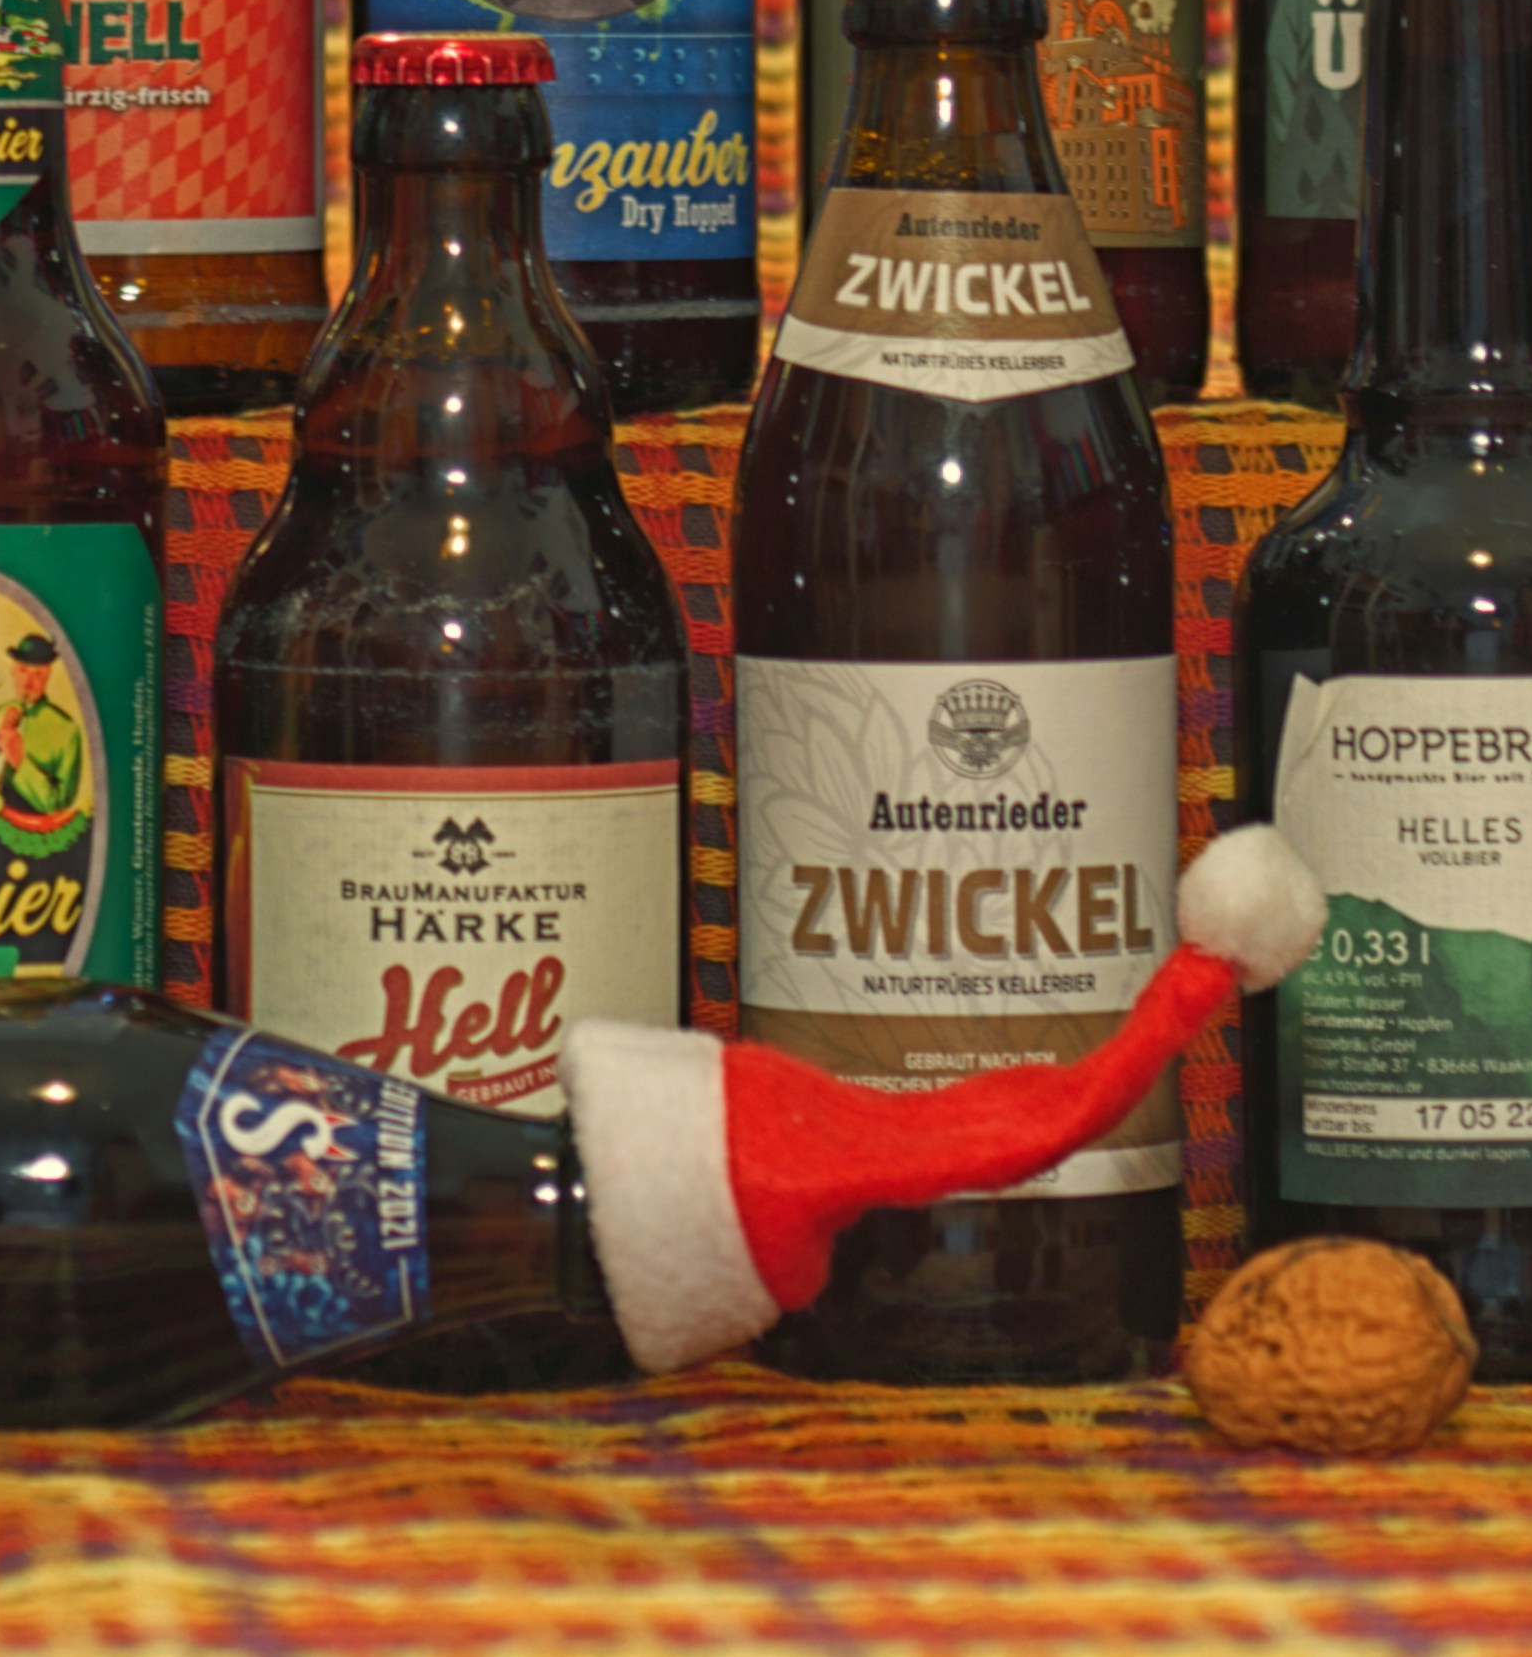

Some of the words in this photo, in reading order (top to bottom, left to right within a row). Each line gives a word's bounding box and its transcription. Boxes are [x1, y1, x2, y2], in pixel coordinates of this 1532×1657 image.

[620, 193, 666, 236] Dry
[672, 192, 737, 233] Hopped
[895, 212, 1042, 241] Autenrieder
[836, 253, 1092, 315] ZWICKEL
[880, 352, 985, 371] NATURTRÜBES
[988, 354, 1066, 371] KELLERBIER
[870, 791, 1087, 832] Autenrieder
[1398, 816, 1523, 844] HELLES
[1418, 850, 1502, 867] VOLLBIER
[370, 906, 562, 943] HÄRKE
[791, 862, 1154, 960] ZWICKEL
[1332, 928, 1410, 968] 0,33
[863, 972, 994, 996] NATURTRÜBES
[999, 972, 1097, 995] KELLERBIER
[336, 955, 565, 1078] Hell
[904, 1052, 977, 1072] GEBRAUT
[980, 1053, 1021, 1071] NACH
[1416, 1103, 1449, 1131] 17
[1458, 1102, 1496, 1131] 05
